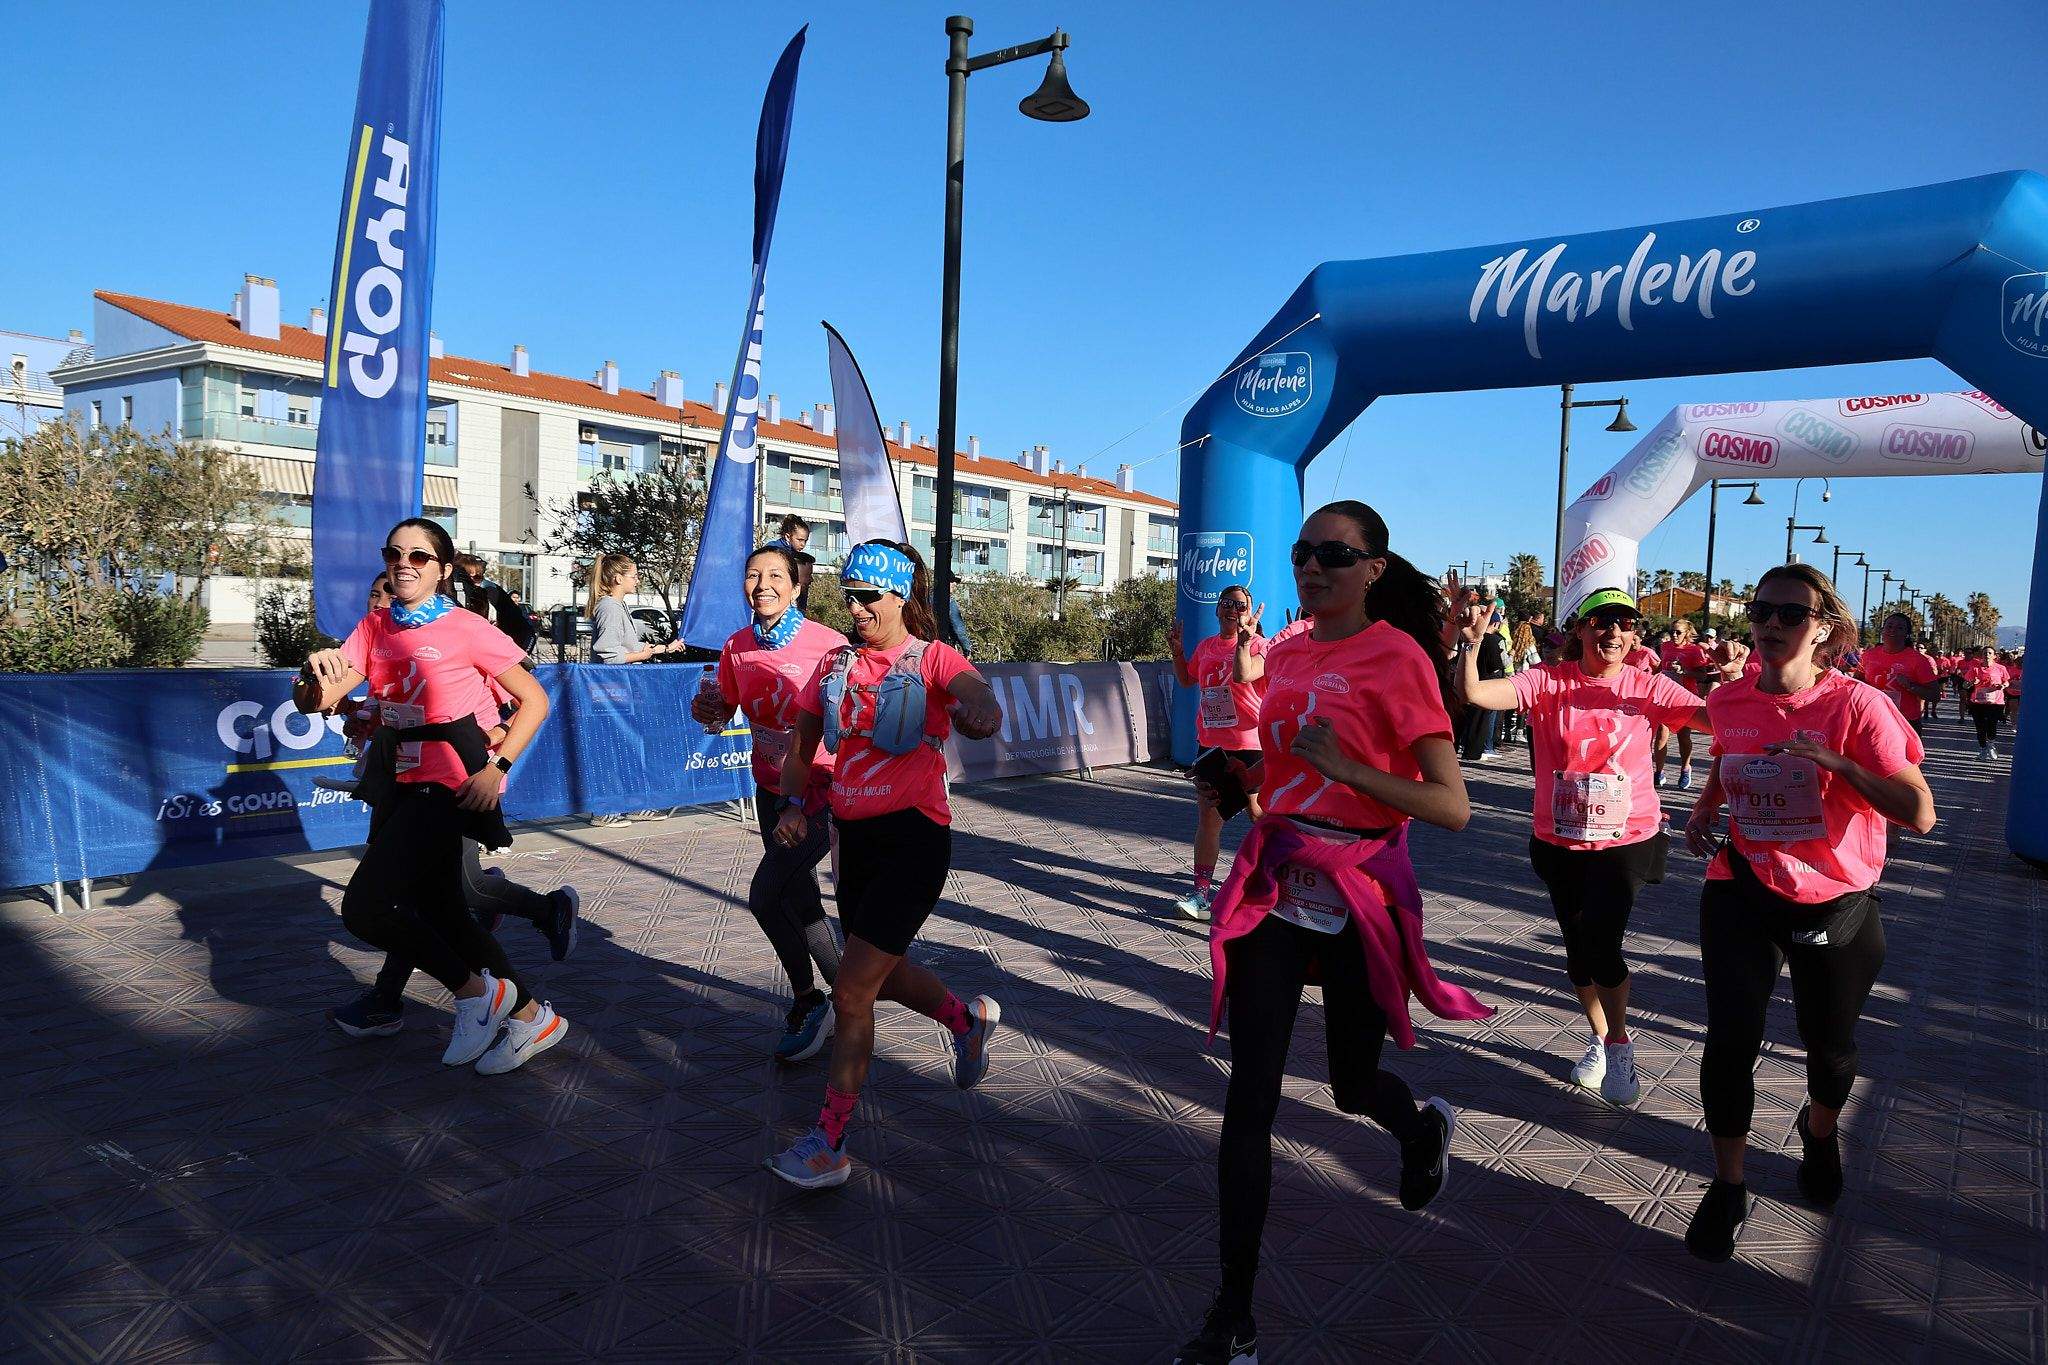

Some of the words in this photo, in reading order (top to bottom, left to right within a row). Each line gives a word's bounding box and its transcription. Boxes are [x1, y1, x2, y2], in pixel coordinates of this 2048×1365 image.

[343, 135, 409, 399] GOYA
[1469, 232, 1757, 359] Marlene
[2011, 292, 2048, 336] M
[2017, 336, 2038, 350] HIJA
[1240, 366, 1306, 400] Marlene
[1241, 398, 1254, 410] HIJA
[1281, 398, 1301, 411] ALPES
[1705, 432, 1773, 464] COSMO
[1784, 412, 1852, 459] COSMO
[1888, 428, 1967, 460] COSMO
[1183, 547, 1247, 584] Marlene
[1562, 538, 1609, 587] COSMO
[1195, 590, 1203, 598] DE
[1724, 728, 1759, 737] OYSHO
[707, 756, 719, 768] es
[199, 800, 222, 817] es
[228, 791, 293, 813] GOYA
[1577, 803, 1606, 816] 016
[1749, 792, 1787, 808] 016
[1299, 913, 1333, 927] Santander
